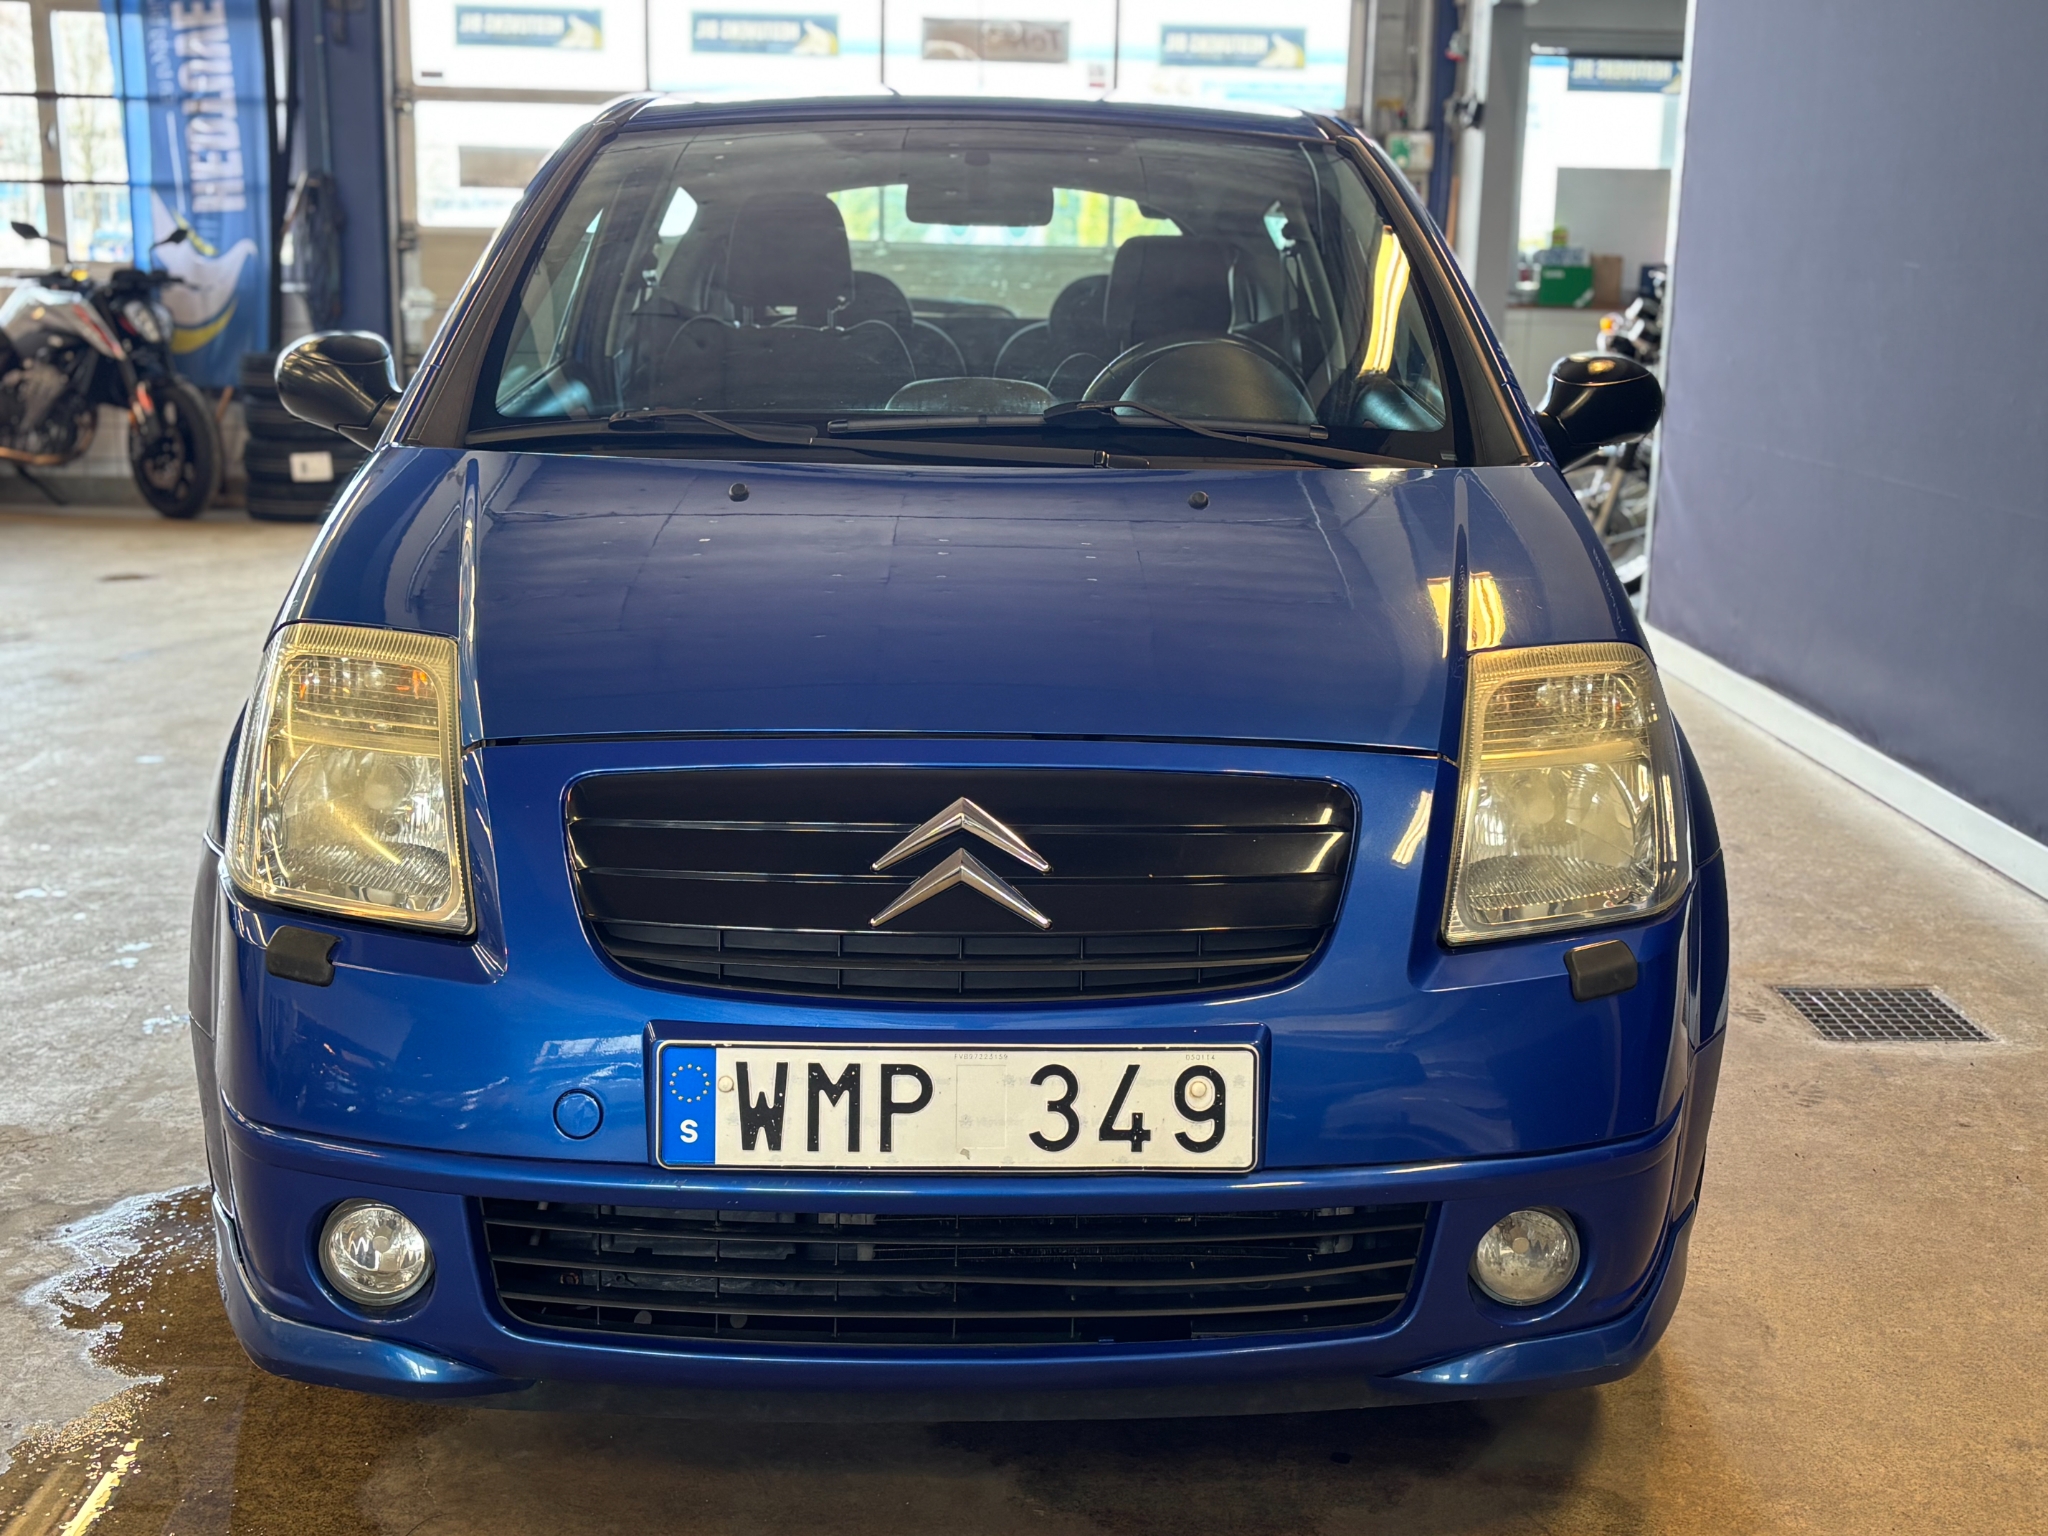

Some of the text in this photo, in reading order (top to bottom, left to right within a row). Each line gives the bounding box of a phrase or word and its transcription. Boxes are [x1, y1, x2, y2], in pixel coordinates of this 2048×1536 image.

[680, 1119, 698, 1143] S
[735, 1062, 1226, 1153] WMP 349
